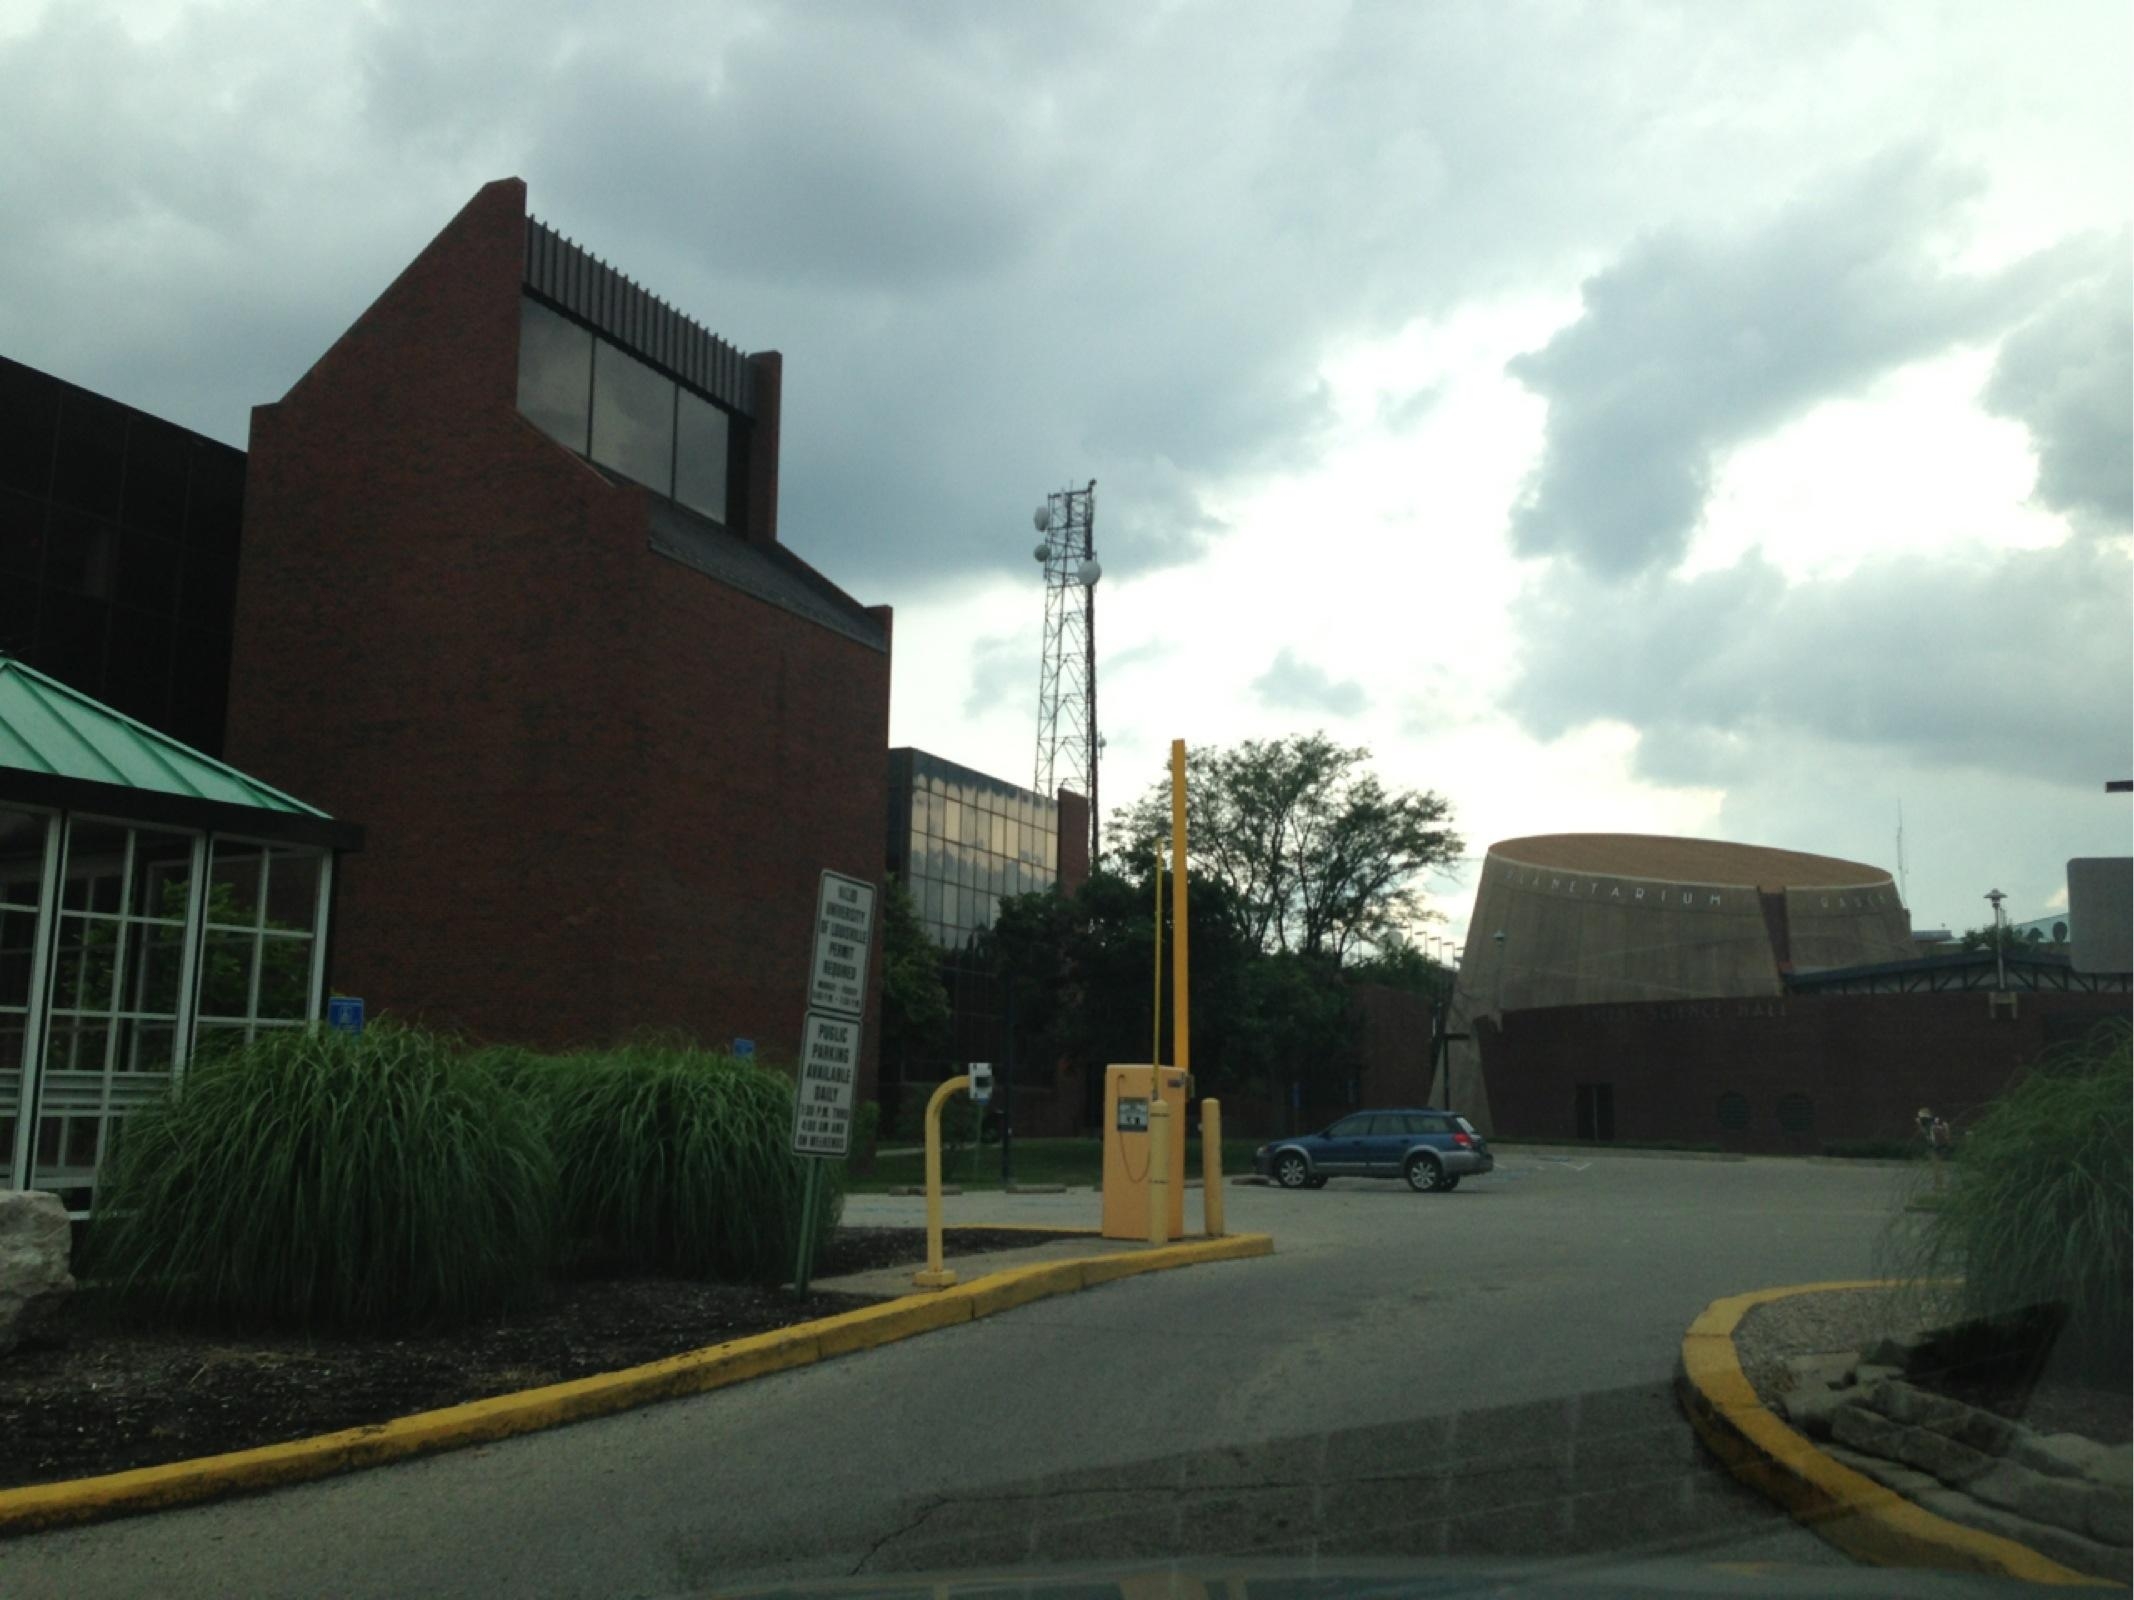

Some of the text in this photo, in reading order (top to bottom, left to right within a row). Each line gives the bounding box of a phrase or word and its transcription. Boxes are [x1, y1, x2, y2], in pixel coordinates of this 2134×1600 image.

[1505, 867, 1721, 906] PLANETARIUM
[826, 901, 865, 924] UNIVERSITY
[821, 920, 867, 944] OF LOUISVILLE
[829, 942, 855, 960] PERMIT
[822, 959, 857, 980] REQUIRED
[818, 1023, 848, 1043] PUBLIC
[812, 1043, 850, 1063] PARKING
[807, 1063, 851, 1084] AVAILABLE
[814, 1086, 839, 1102] DAILY
